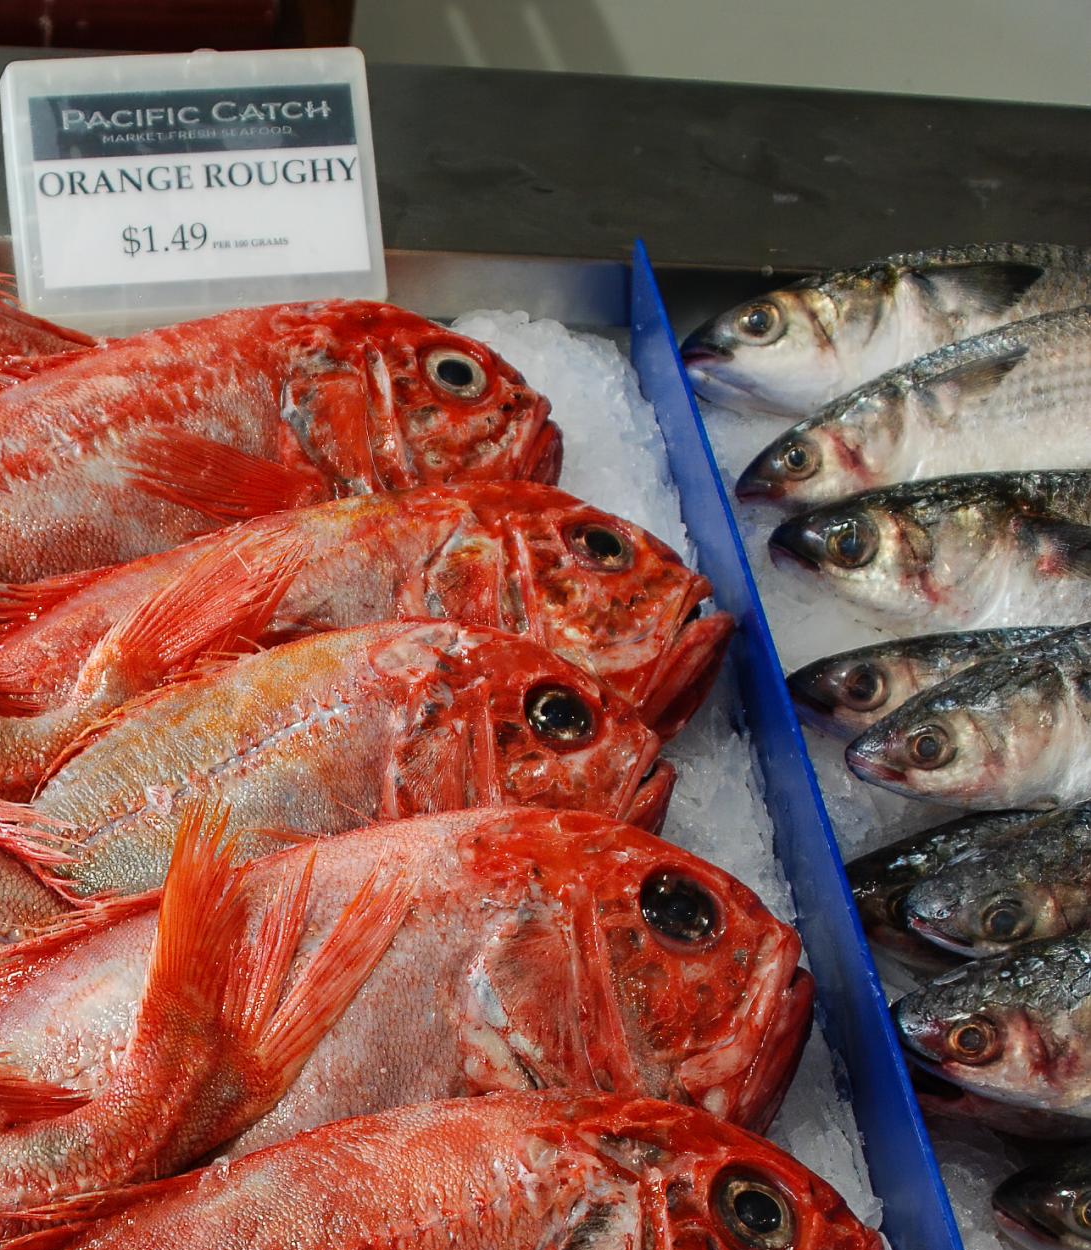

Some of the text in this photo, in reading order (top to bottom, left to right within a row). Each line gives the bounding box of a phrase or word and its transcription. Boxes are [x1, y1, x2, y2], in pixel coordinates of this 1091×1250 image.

[61, 100, 331, 130] PACIFIC CATCH
[102, 132, 163, 144] MARKET
[221, 125, 292, 137] SEAFOOD
[38, 156, 357, 197] ORANGE ROUGHY
[122, 222, 207, 257] $1.49
[212, 240, 231, 249] PER
[251, 237, 289, 248] GRAMS
